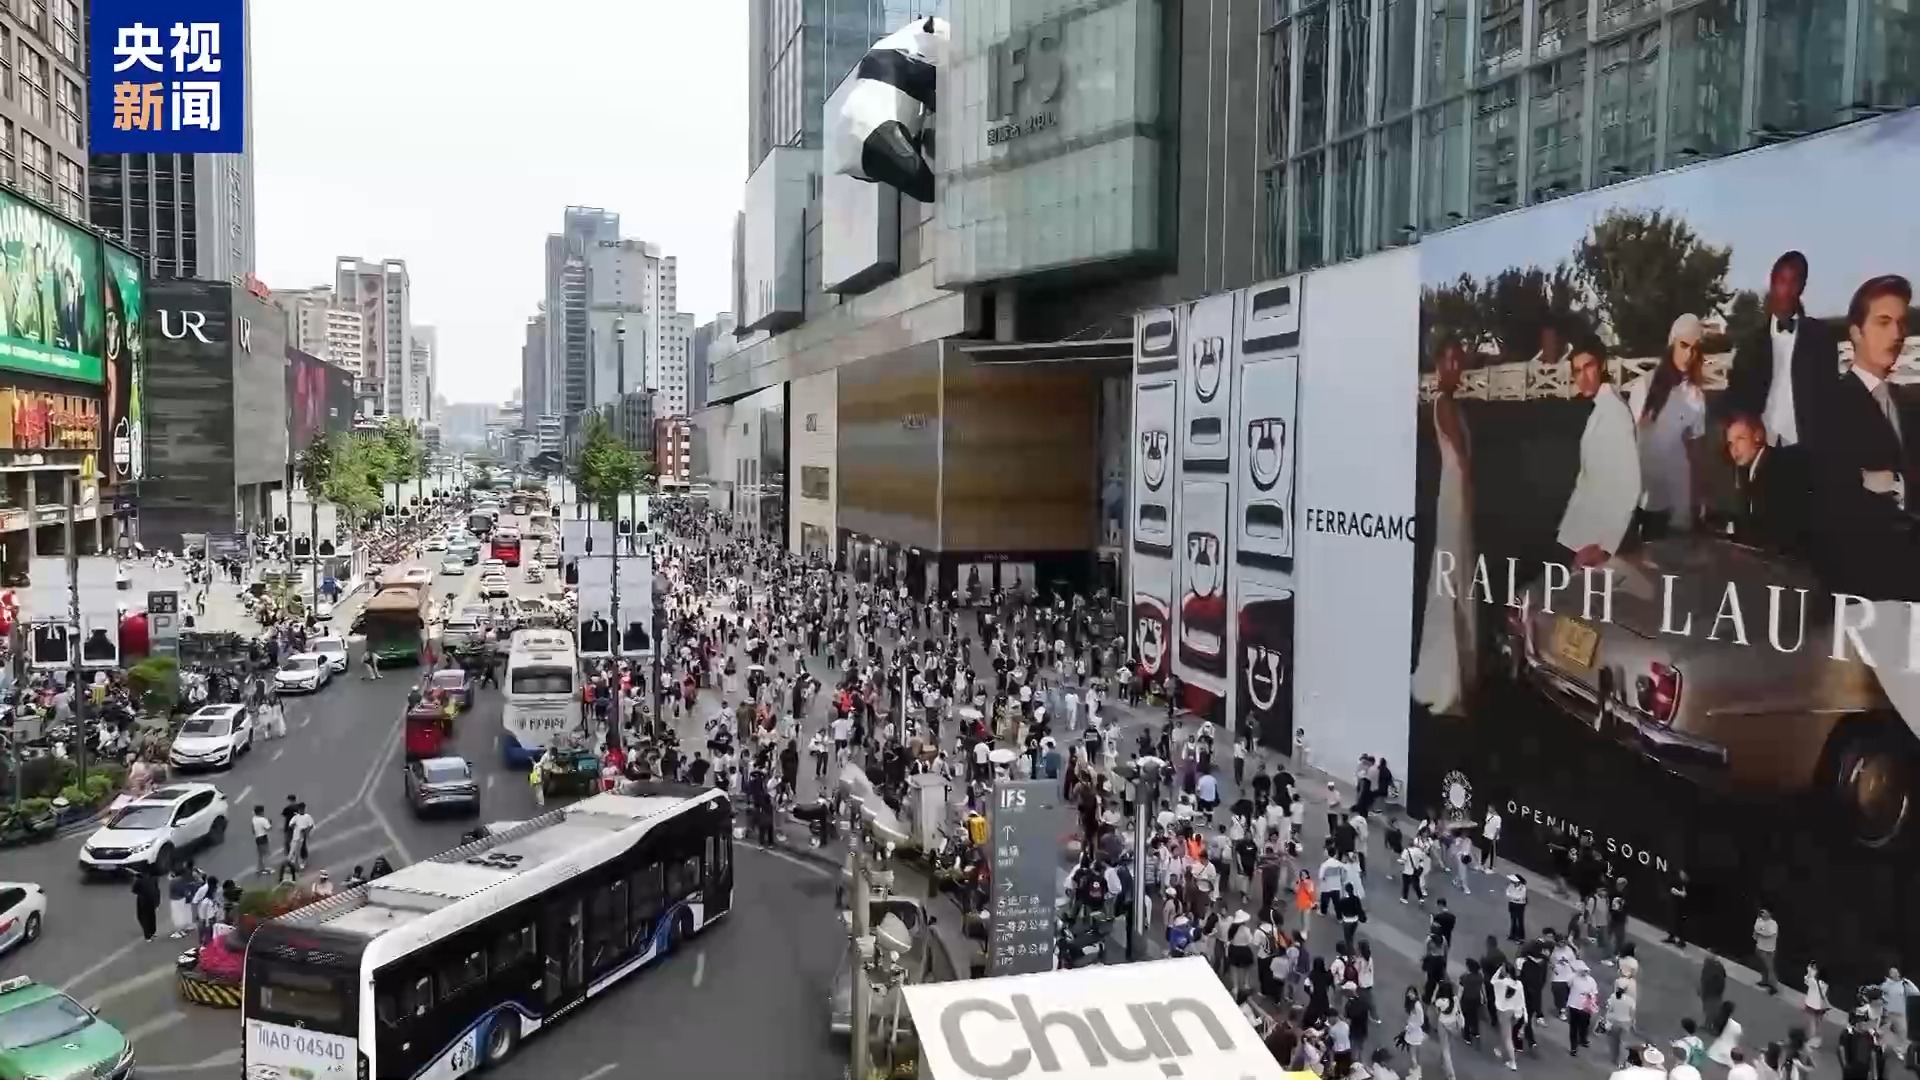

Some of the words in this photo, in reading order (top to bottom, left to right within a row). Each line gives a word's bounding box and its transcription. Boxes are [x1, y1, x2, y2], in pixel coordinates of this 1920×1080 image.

[157, 309, 214, 343] UR
[239, 316, 251, 353] UR
[154, 615, 170, 634] P
[1436, 550, 1613, 623] RALPH
[1660, 574, 1920, 672] LAUR
[1001, 789, 1026, 808] IFS
[1606, 837, 1667, 872] SOON
[940, 993, 1237, 1079] Chun
